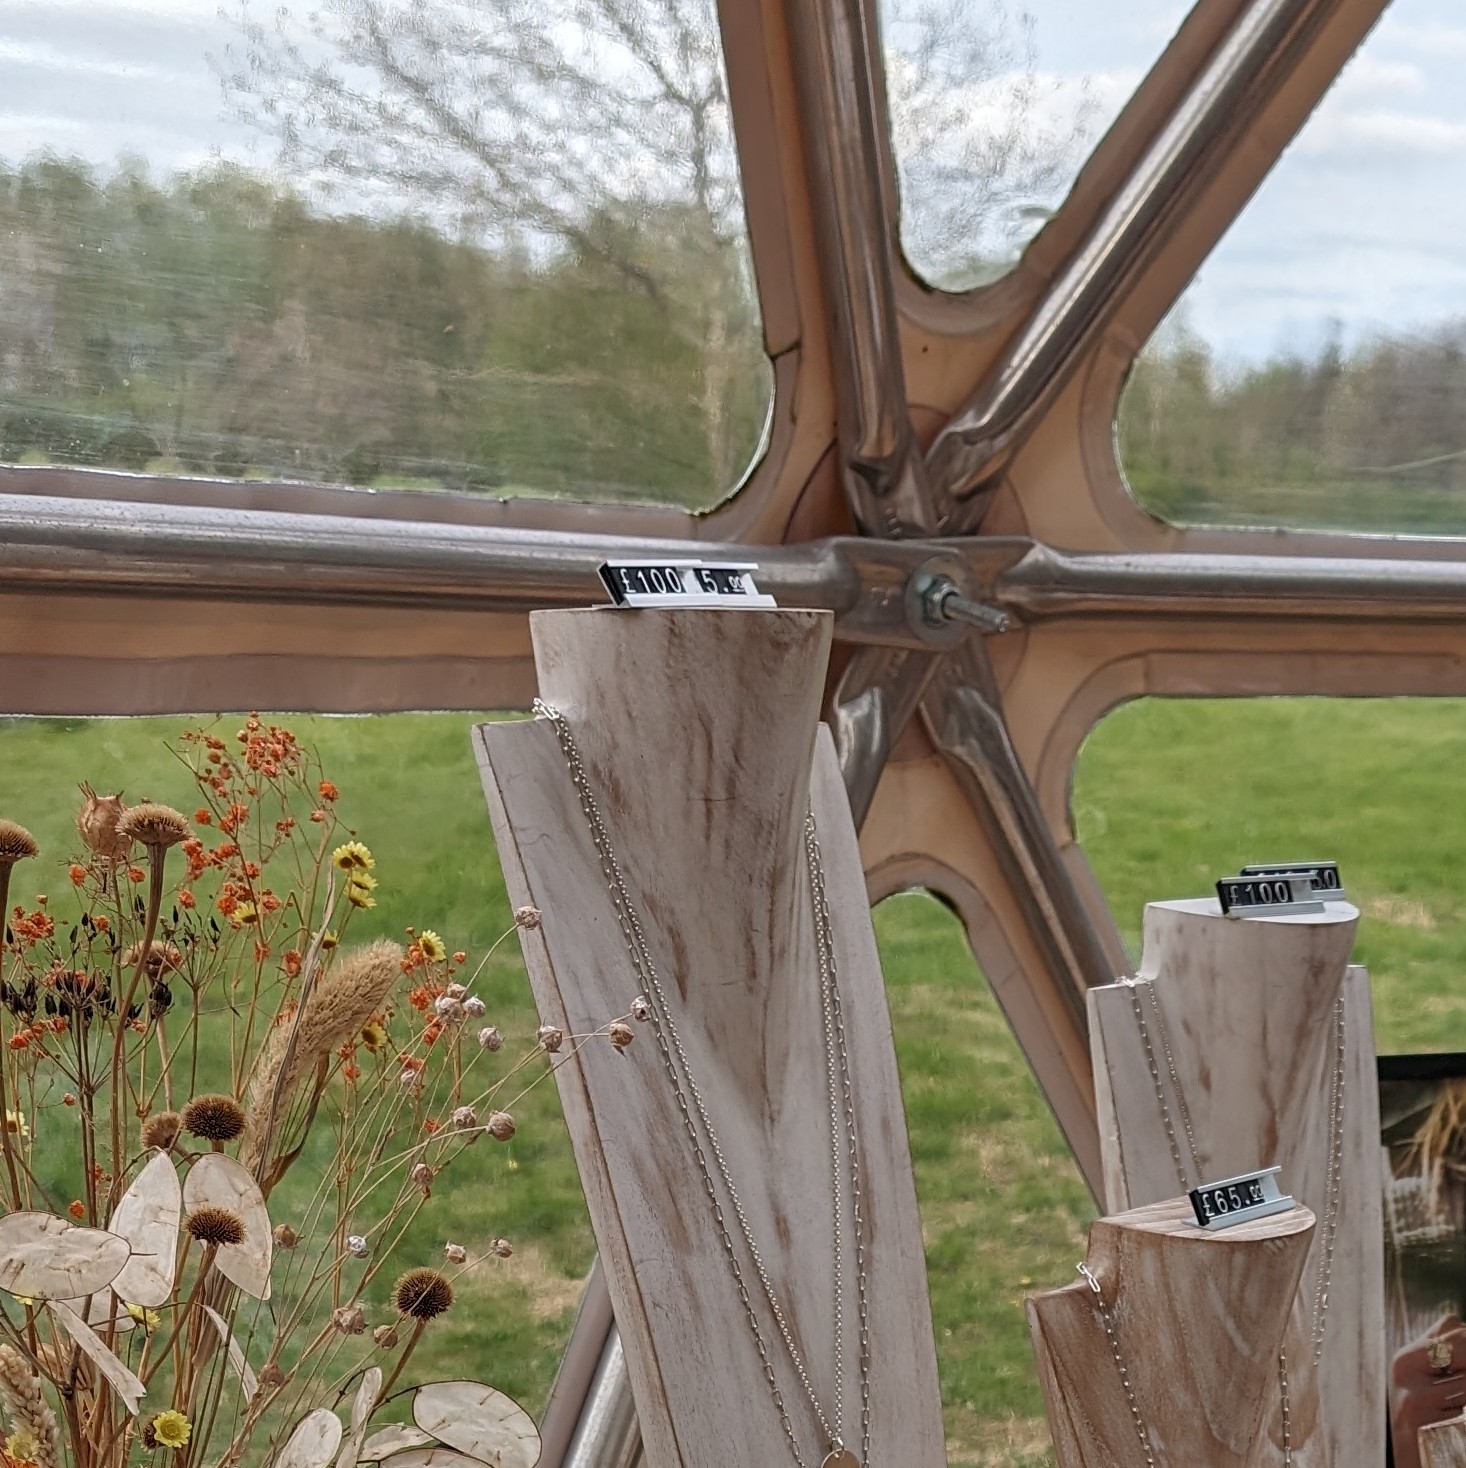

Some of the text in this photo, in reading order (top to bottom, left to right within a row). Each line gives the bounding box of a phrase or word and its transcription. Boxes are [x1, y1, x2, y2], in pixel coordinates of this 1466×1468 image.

[619, 567, 682, 595] £100
[1229, 881, 1289, 906] £100
[1201, 1184, 1264, 1217] £65.00
